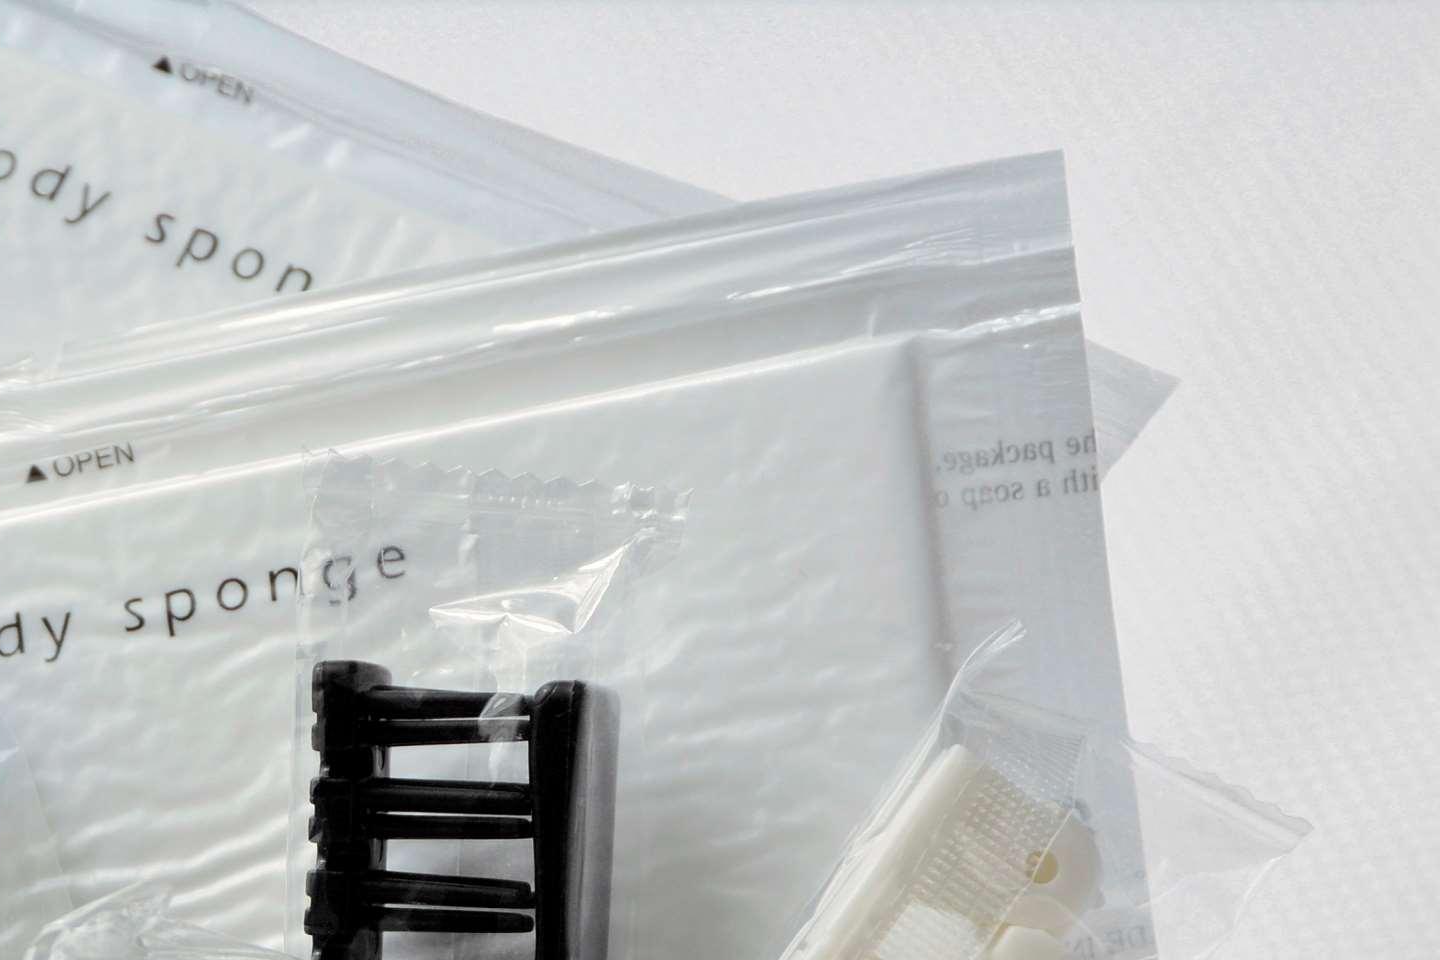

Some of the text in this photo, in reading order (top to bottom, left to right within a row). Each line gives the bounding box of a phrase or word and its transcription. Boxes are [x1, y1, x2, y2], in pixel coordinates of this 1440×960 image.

[179, 62, 256, 105] OPEN
[144, 210, 316, 293] spon
[51, 441, 136, 480] OPEN
[124, 543, 408, 638] sponge
